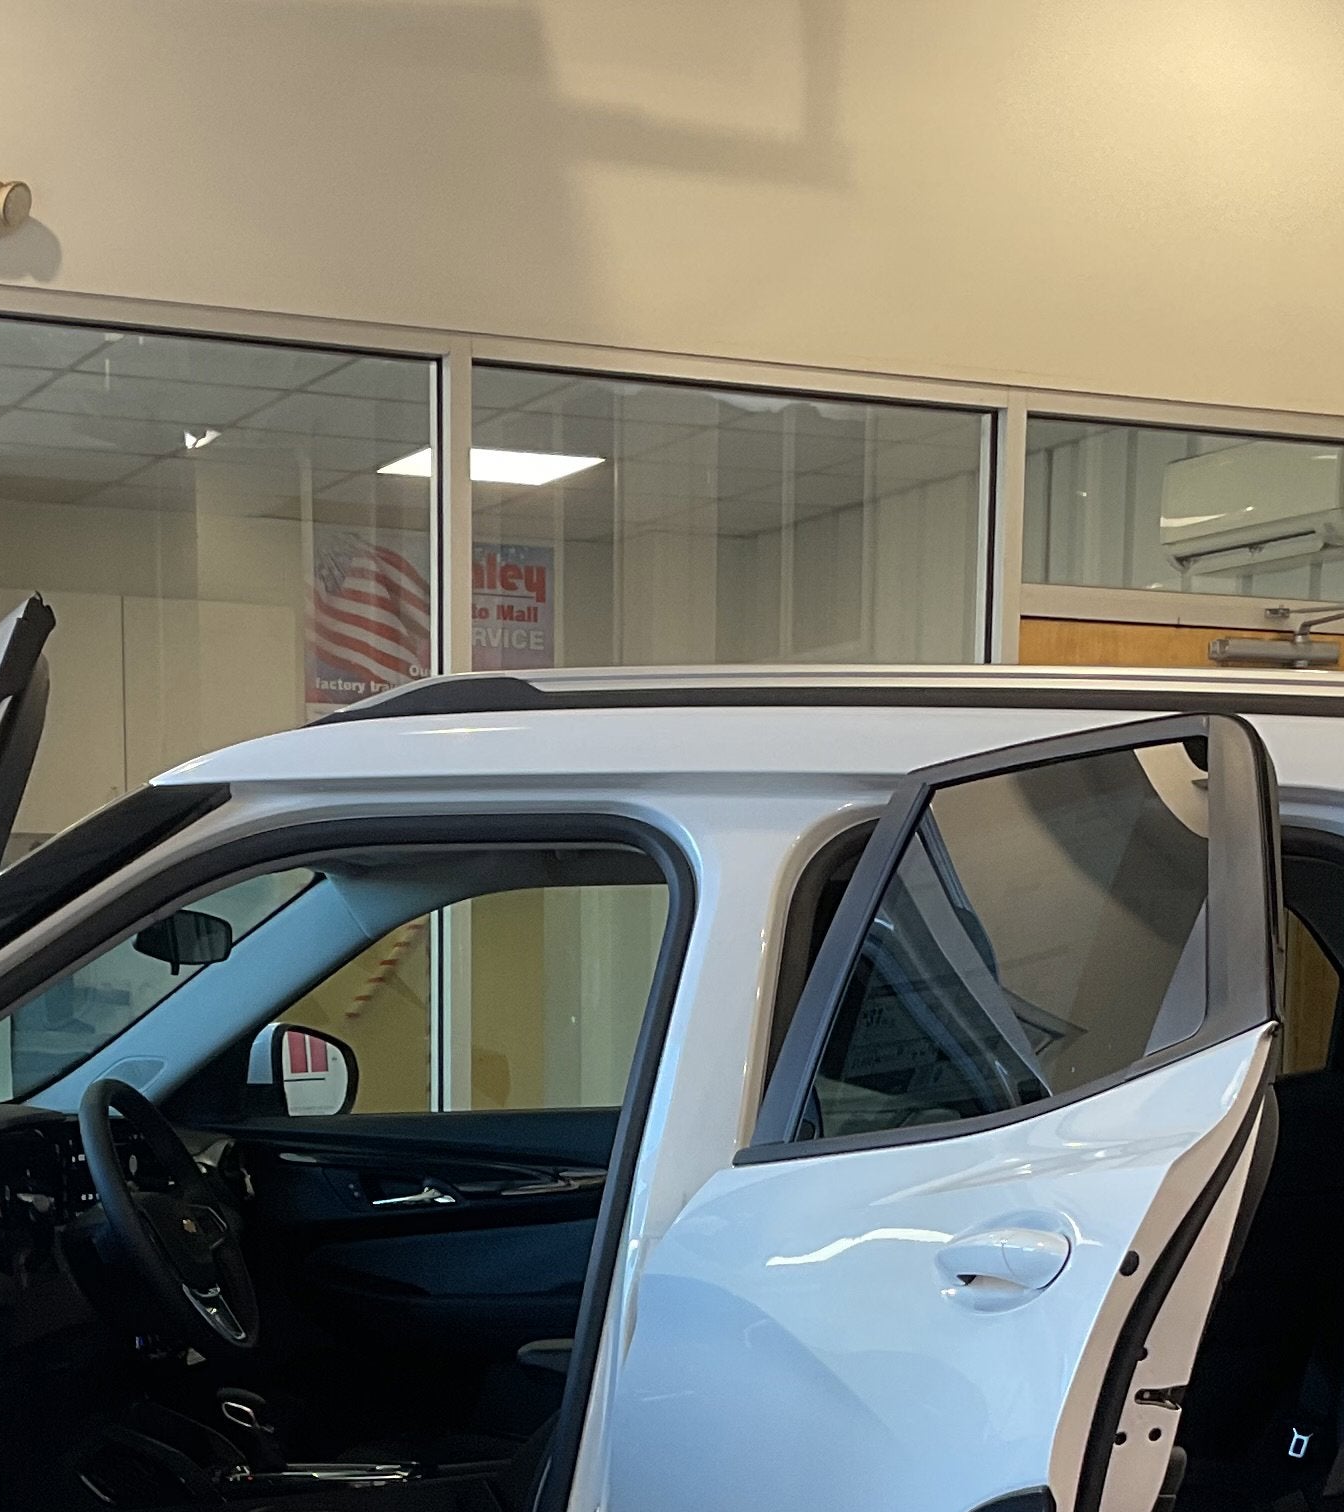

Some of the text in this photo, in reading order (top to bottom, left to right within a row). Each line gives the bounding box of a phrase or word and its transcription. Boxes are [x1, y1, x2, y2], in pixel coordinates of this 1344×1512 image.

[496, 604, 539, 623] Mall
[408, 664, 431, 677] Ou
[315, 677, 366, 693] factory
